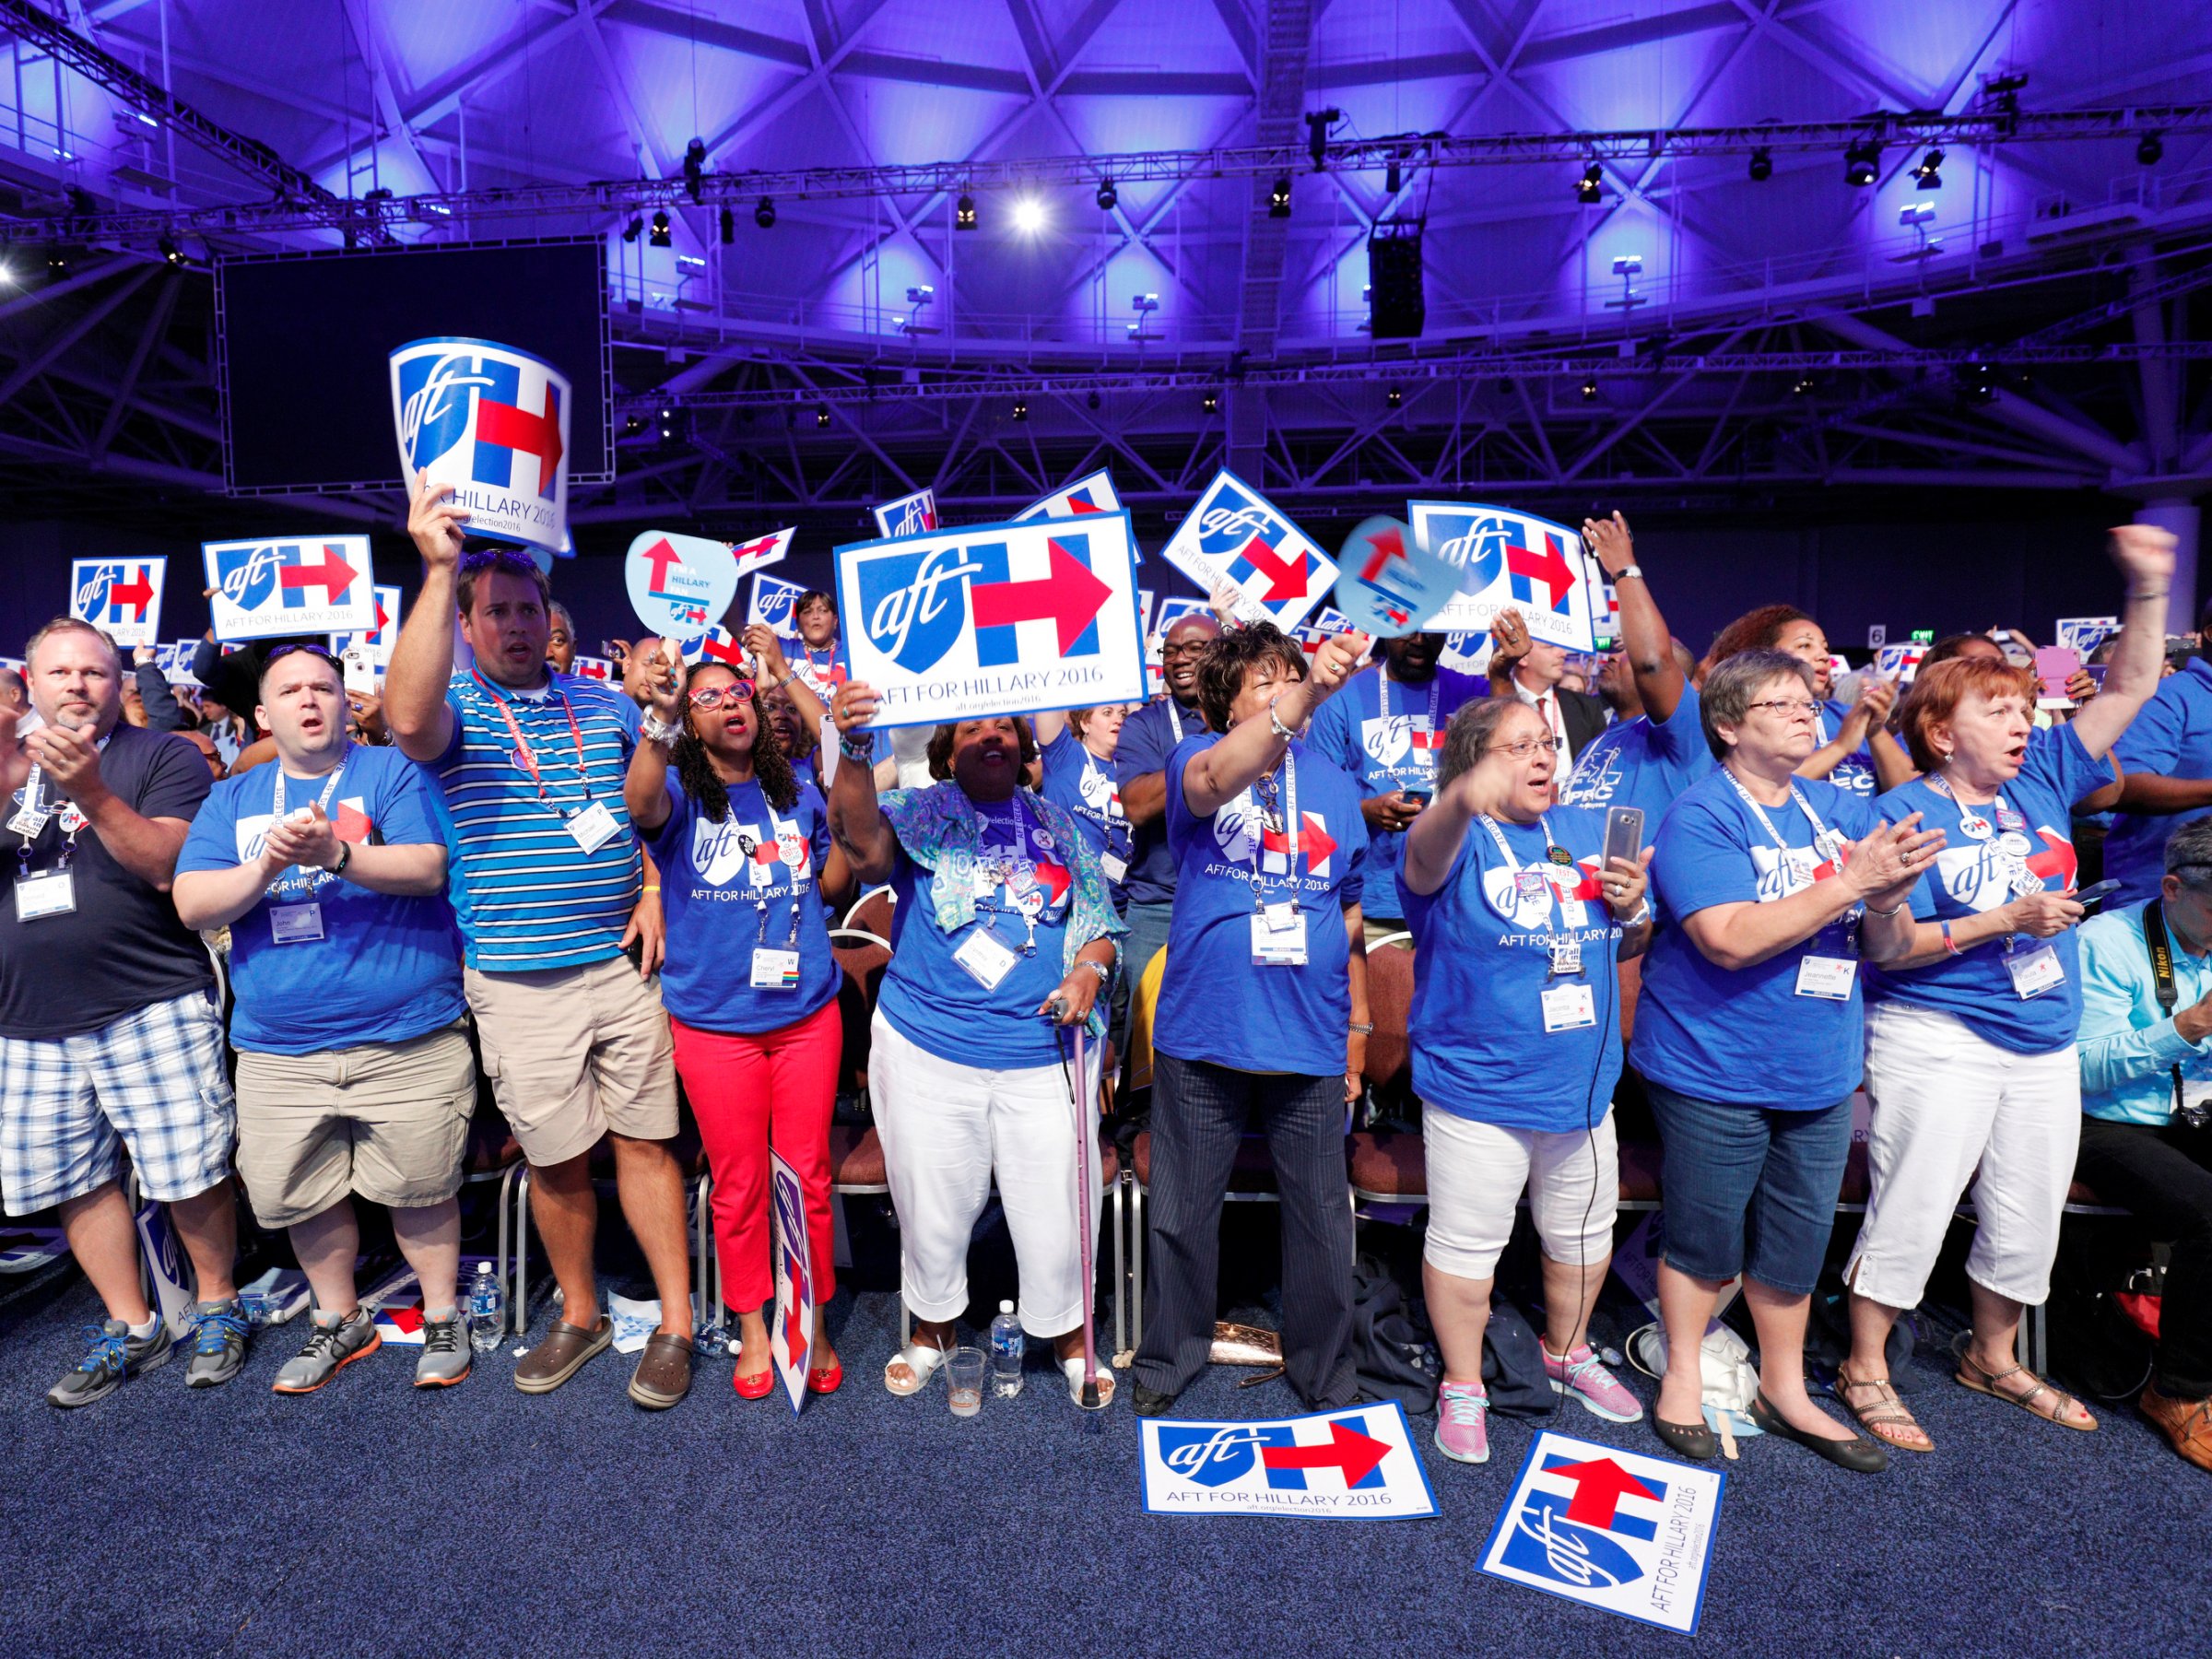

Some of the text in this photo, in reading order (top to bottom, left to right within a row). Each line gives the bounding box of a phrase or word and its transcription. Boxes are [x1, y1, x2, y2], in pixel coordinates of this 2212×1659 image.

[403, 354, 496, 459] aft
[452, 489, 531, 519] HILLARY
[533, 505, 556, 530] 2016
[1199, 505, 1270, 540] aft
[224, 547, 288, 606] aft
[1177, 545, 1198, 565] AFT
[1196, 559, 1213, 579] FOR
[77, 565, 117, 615] aft
[671, 575, 712, 589] HILLARY
[225, 608, 354, 629] AFT FOR HILLARY 2016
[759, 586, 799, 617] aft
[871, 547, 983, 662] aft
[131, 627, 147, 637] 2016
[1467, 604, 1500, 618] FOR
[1548, 617, 1573, 635] 2016
[1872, 629, 1883, 643] 6
[1466, 660, 1485, 669] FOR
[875, 665, 1104, 705] AFT FOR HILLARY 2016
[499, 702, 518, 731] DELEGATE
[1428, 688, 1439, 725] DELEGATE
[1286, 749, 1297, 796] DELEGATE
[1368, 770, 1386, 781] AFT
[275, 787, 285, 826] DELEGATE
[1073, 804, 1087, 813] AFT
[1087, 808, 1101, 820] FOR
[1244, 806, 1257, 855] DELEGATE
[1478, 812, 1506, 847] ELEGATE
[696, 821, 737, 876] aft
[1205, 863, 1226, 875] AFT
[1225, 866, 1249, 882] FOR
[1304, 878, 1330, 891] 2016
[1953, 843, 2001, 905] aft
[691, 888, 712, 900] AFT
[713, 890, 738, 901] FOR
[1499, 934, 1526, 947] AFT
[1529, 932, 1552, 947] FOR
[2157, 946, 2171, 980] Nikon
[1169, 1429, 1271, 1478] aft
[1166, 1490, 1393, 1507] AFT FOR HILLARY 2016
[1246, 1503, 1332, 1514] aft.org/election2016
[1517, 1504, 1621, 1586] aft
[1650, 1485, 1697, 1614] AFT FOR HILLARY 2016
